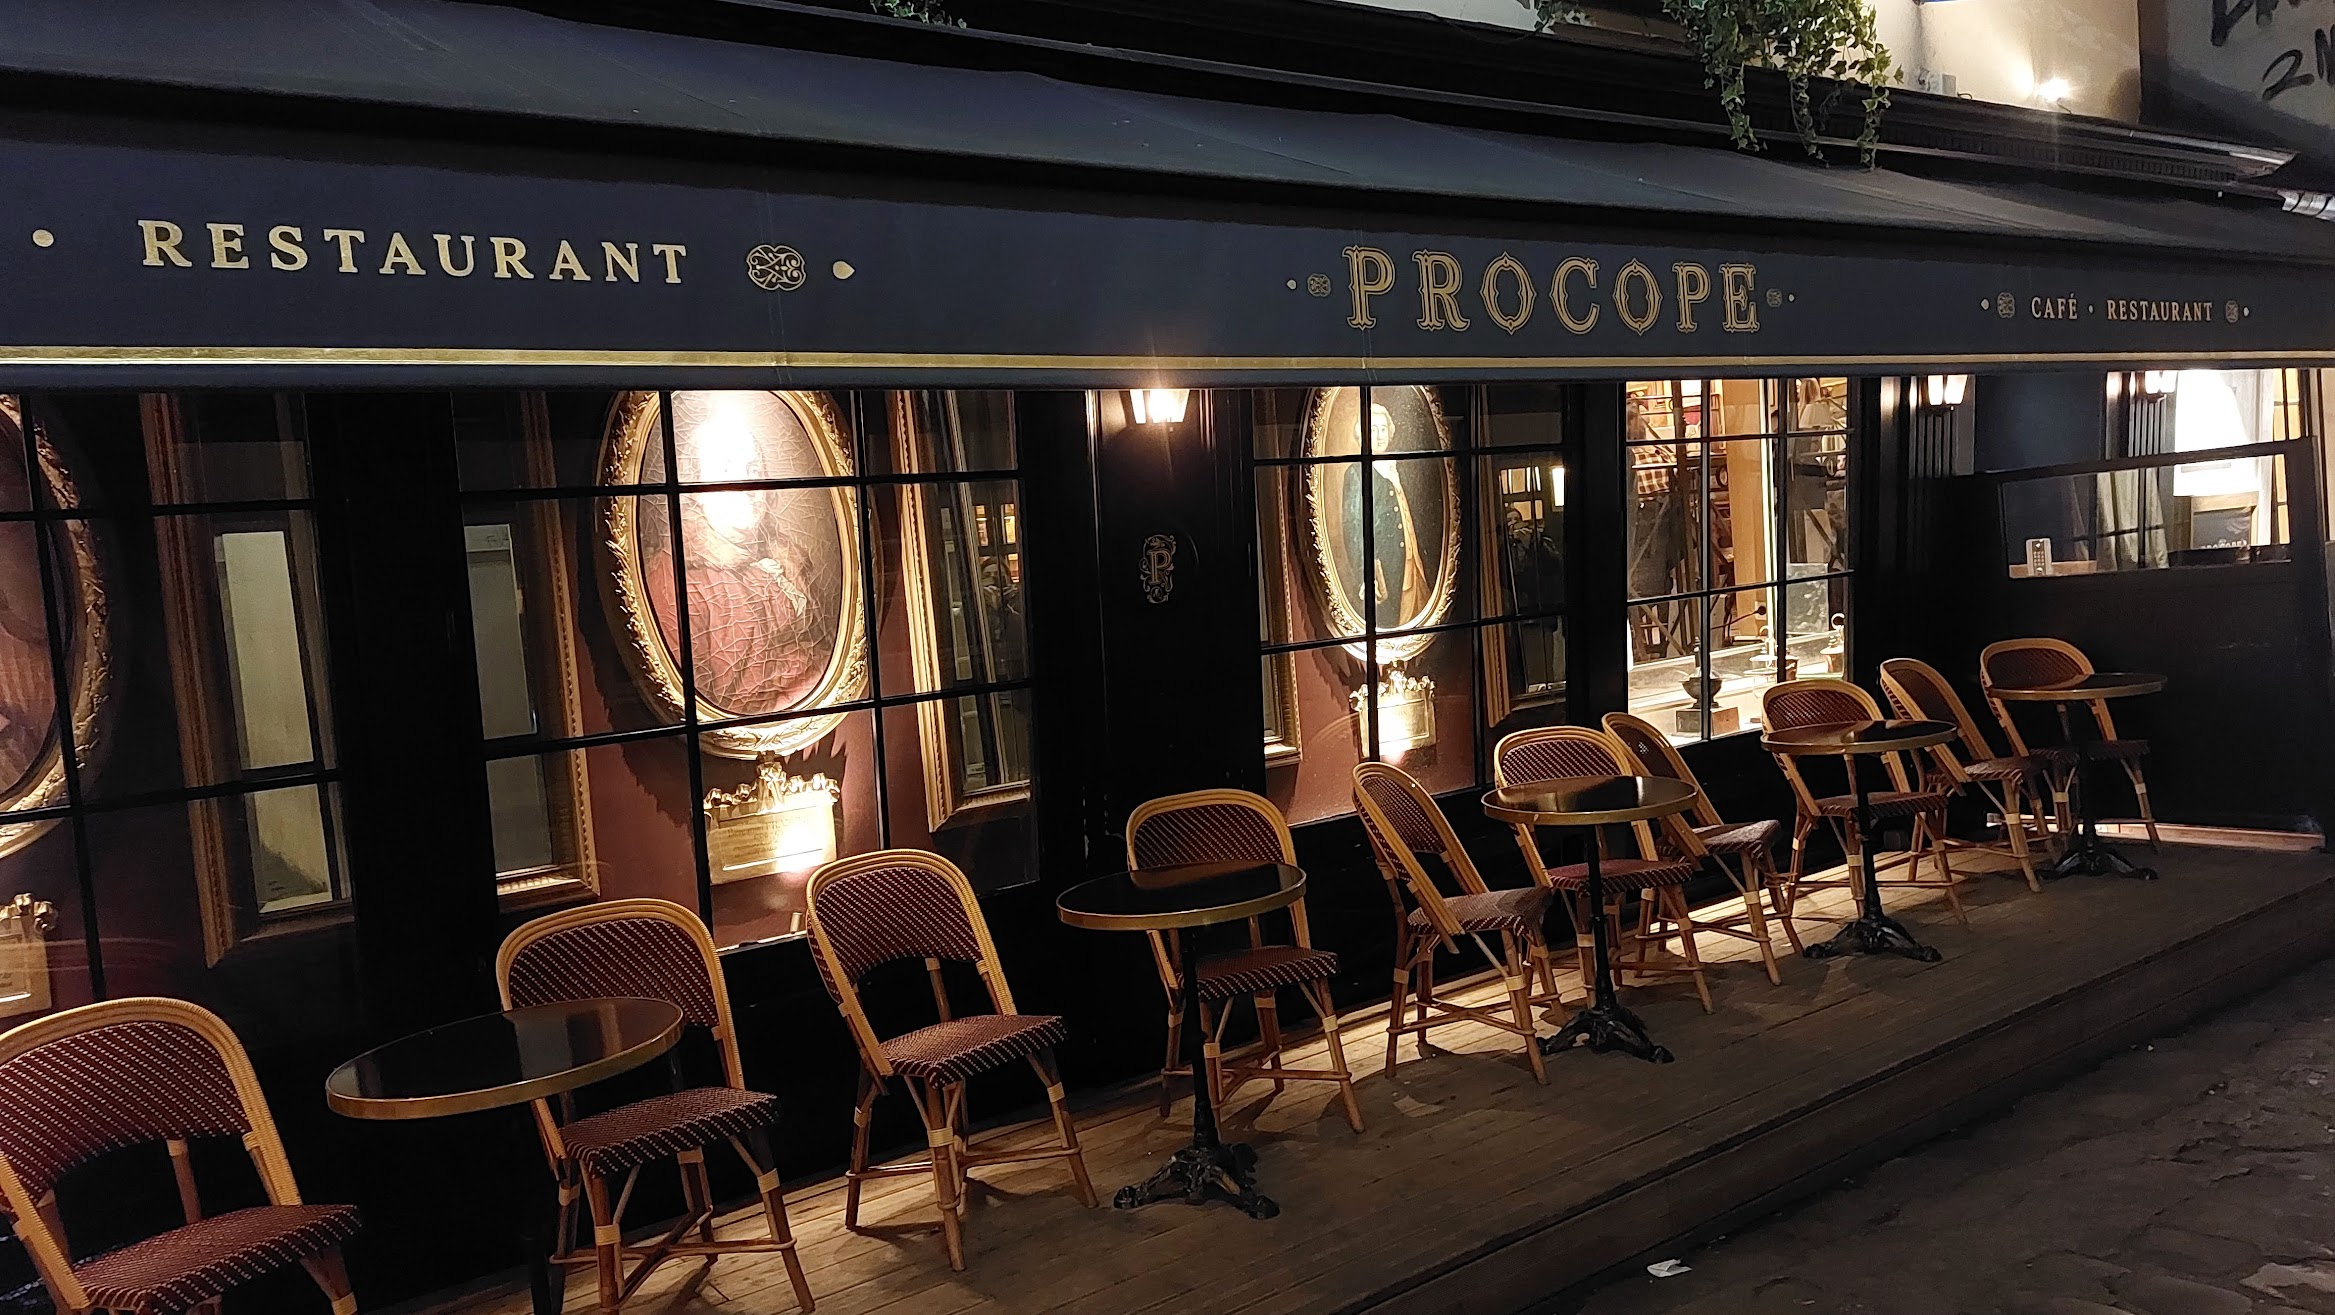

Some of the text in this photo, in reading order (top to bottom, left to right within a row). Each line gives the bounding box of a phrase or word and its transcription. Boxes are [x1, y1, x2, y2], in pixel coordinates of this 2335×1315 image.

[138, 219, 687, 284] RESTAURANT
[1341, 244, 1760, 336] PROCOPE
[2031, 293, 2213, 322] CAFÉ RESTAURANT
[1147, 548, 1172, 585] P
